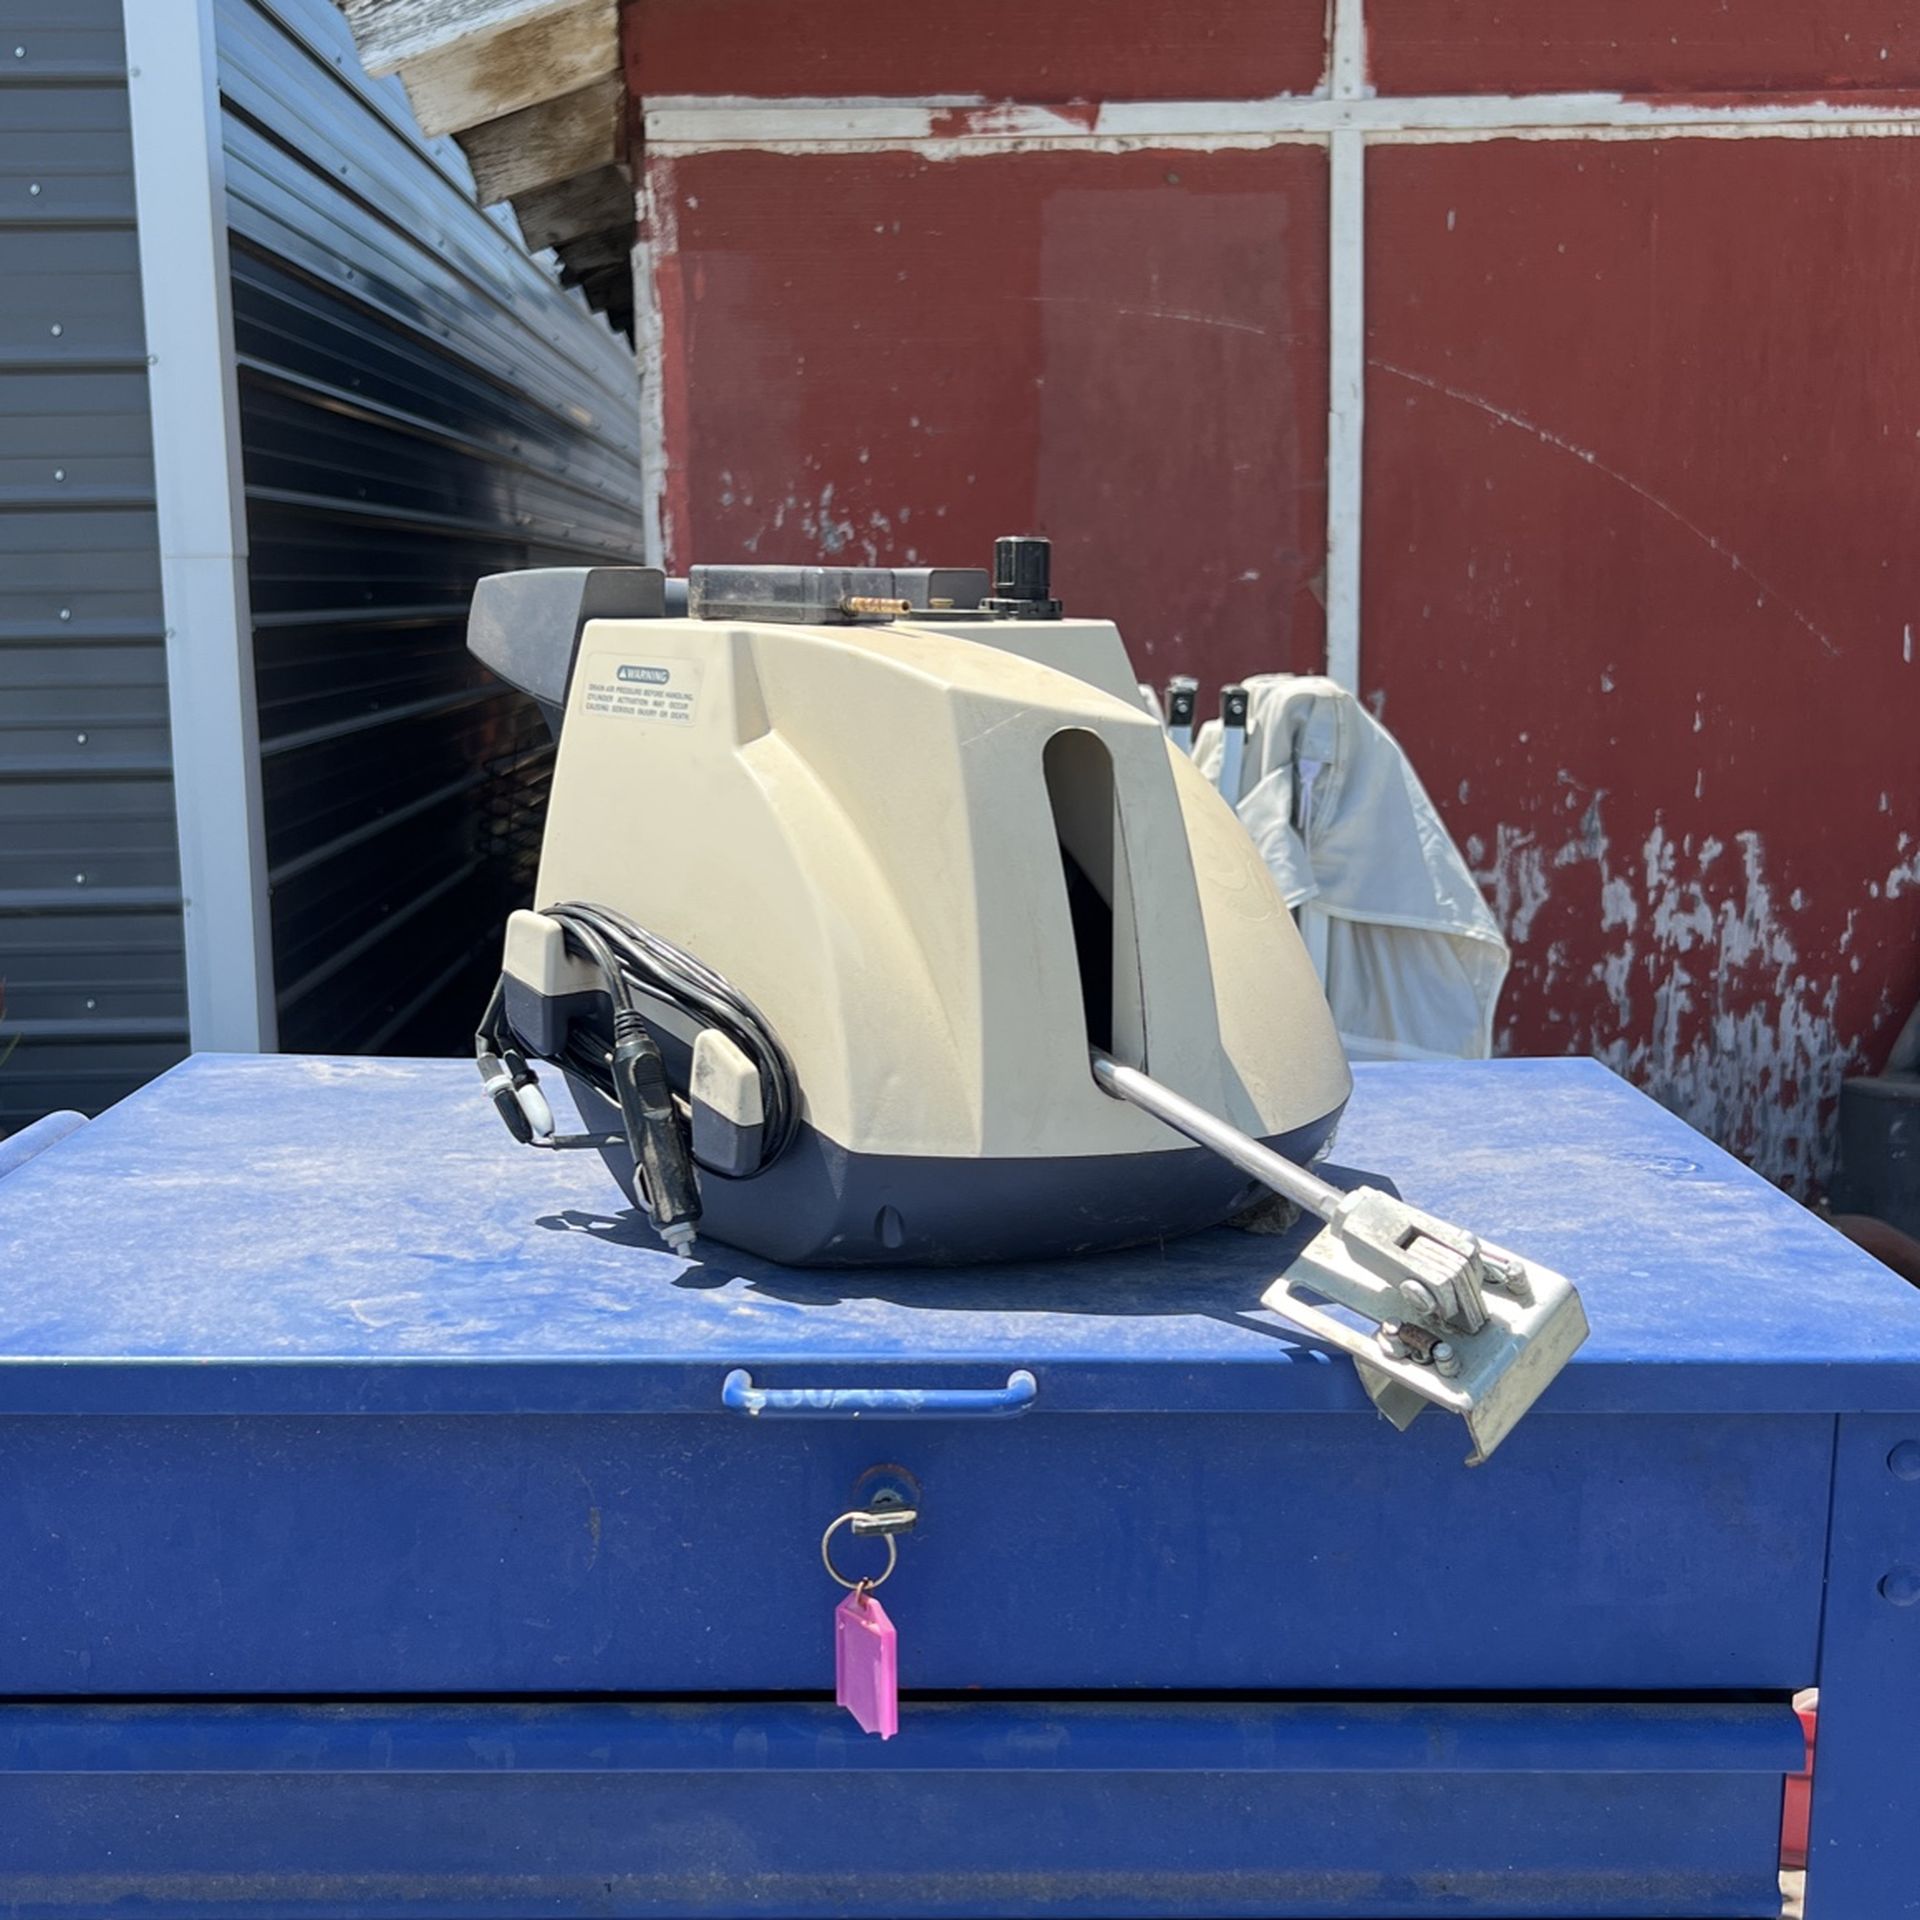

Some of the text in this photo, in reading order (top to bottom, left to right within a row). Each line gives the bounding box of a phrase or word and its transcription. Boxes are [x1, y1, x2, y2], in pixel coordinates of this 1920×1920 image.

[627, 668, 668, 682] WARNING
[588, 684, 605, 692] DRAIN
[616, 686, 642, 695] PRESSURE
[643, 689, 664, 697] BEFORE
[587, 693, 689, 710] CYLINDER ACTIVATION MAY OCCUR
[586, 702, 610, 711] CAUSING
[612, 705, 635, 714] SERIOUS
[637, 708, 658, 717] INJURY
